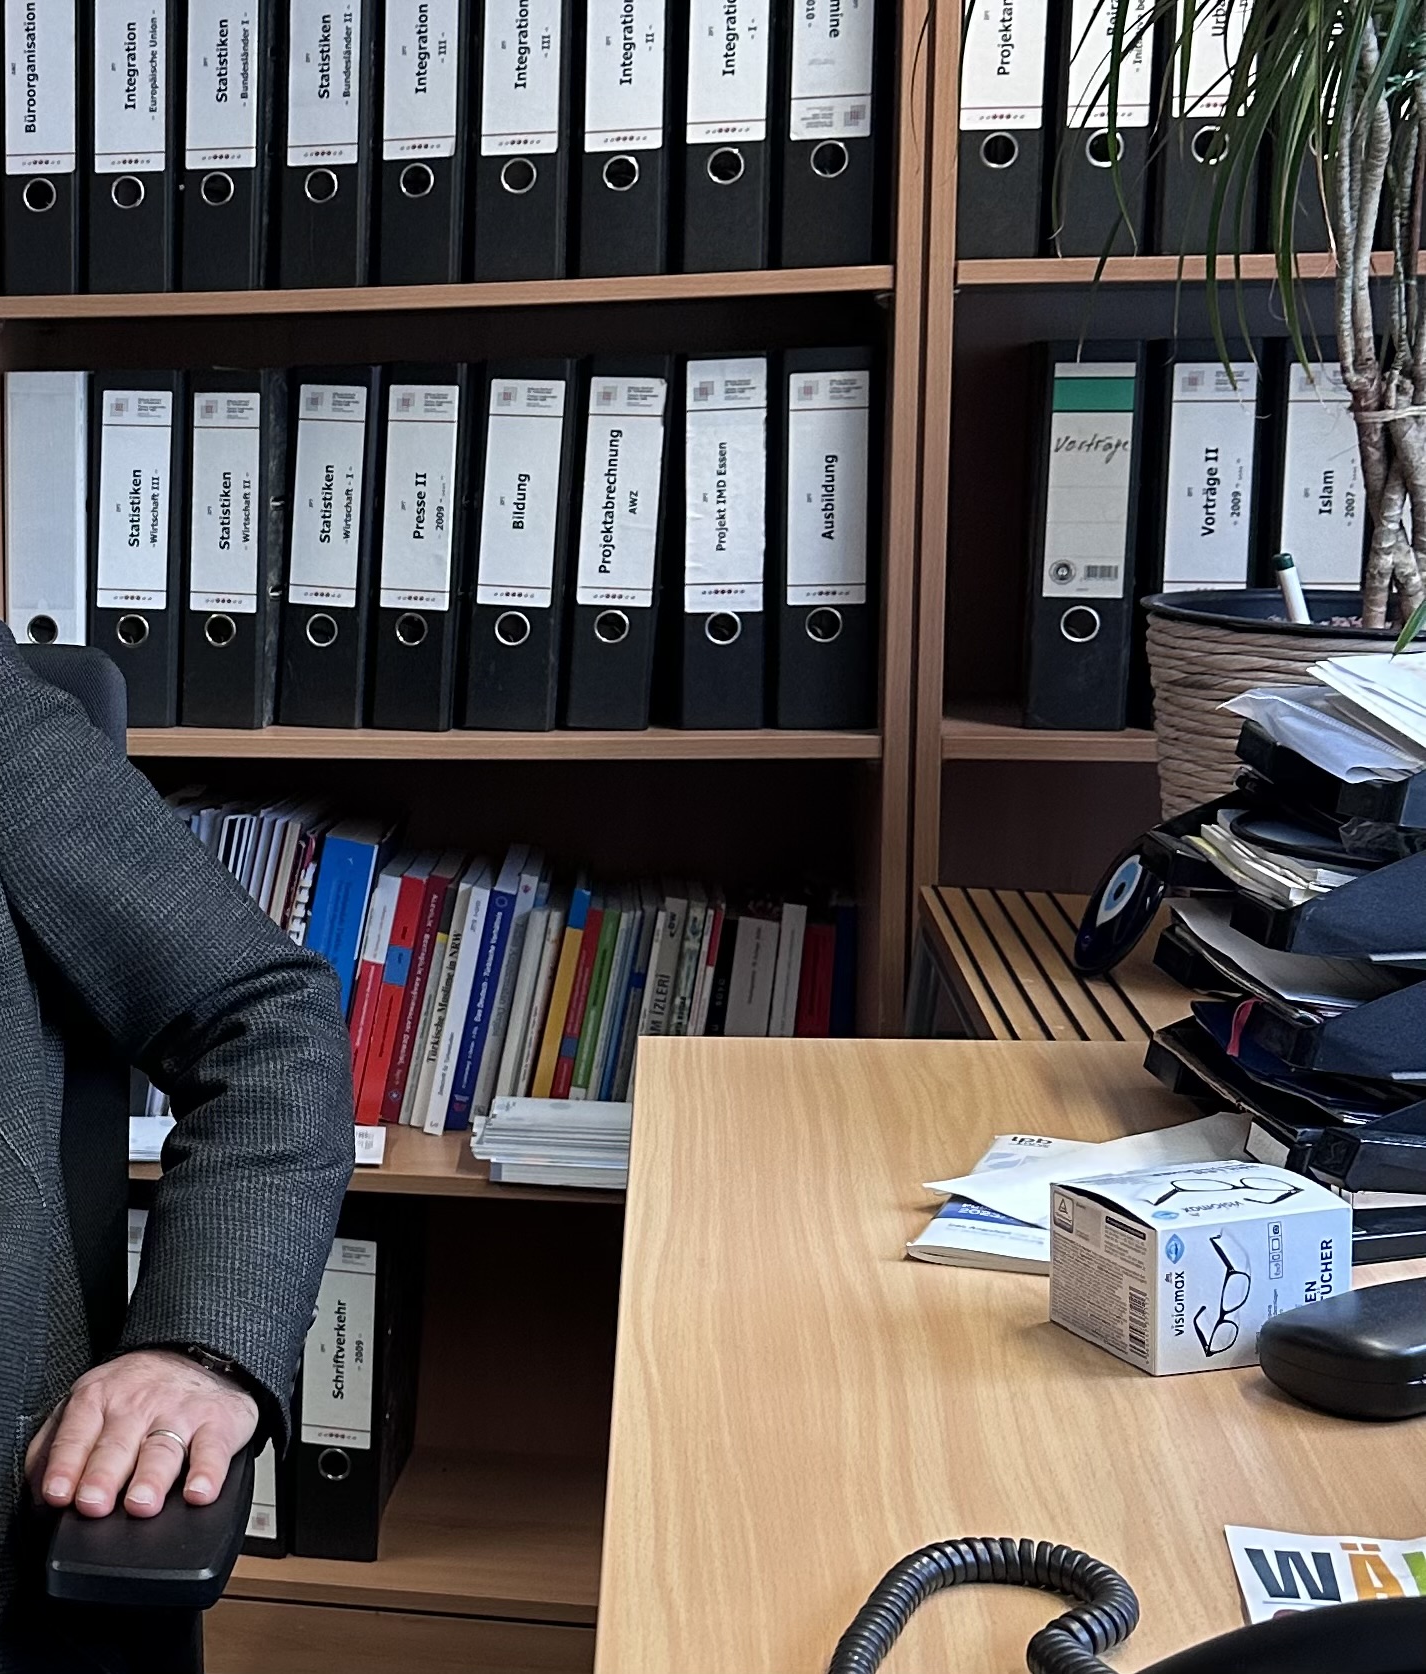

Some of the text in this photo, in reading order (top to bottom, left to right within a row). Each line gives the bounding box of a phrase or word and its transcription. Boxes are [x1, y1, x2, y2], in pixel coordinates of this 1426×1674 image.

[24, 2, 39, 133] Büroorganisation
[124, 22, 139, 110] Integration
[149, 16, 159, 113] Europäische Union
[216, 19, 229, 103] Statistiken
[241, 30, 250, 99] Bundesländer
[318, 14, 331, 99] Statistiken
[343, 25, 352, 98] Bundesländer
[415, 4, 431, 94] Integration
[515, 0, 531, 89] Integration
[128, 469, 141, 548] Statistiken
[219, 471, 231, 550] Statistiken
[319, 464, 334, 543] Statistiken
[413, 491, 426, 539] Presse
[435, 505, 445, 531] 2009
[512, 473, 530, 529] Bildung
[598, 429, 623, 574] Projektabrechnung
[629, 490, 638, 515] AWZ
[716, 442, 729, 551] Projekt IMD Essen
[821, 454, 838, 540] Ausbildung
[1201, 467, 1221, 537] Vorträge
[1230, 491, 1243, 518] 2009
[1319, 469, 1334, 515] Islam
[1345, 491, 1357, 519] 2007
[427, 1016, 445, 1063] Türkische
[437, 971, 454, 1014] Muslime
[449, 930, 463, 958] NRW
[477, 981, 488, 1008] Deutsch
[653, 973, 671, 1016] İZLERİ
[1172, 1269, 1186, 1337] visiomax
[1316, 1238, 1334, 1300] ÜCHER
[332, 1299, 347, 1400] Schriftverkehr
[354, 1339, 364, 1364] 2009
